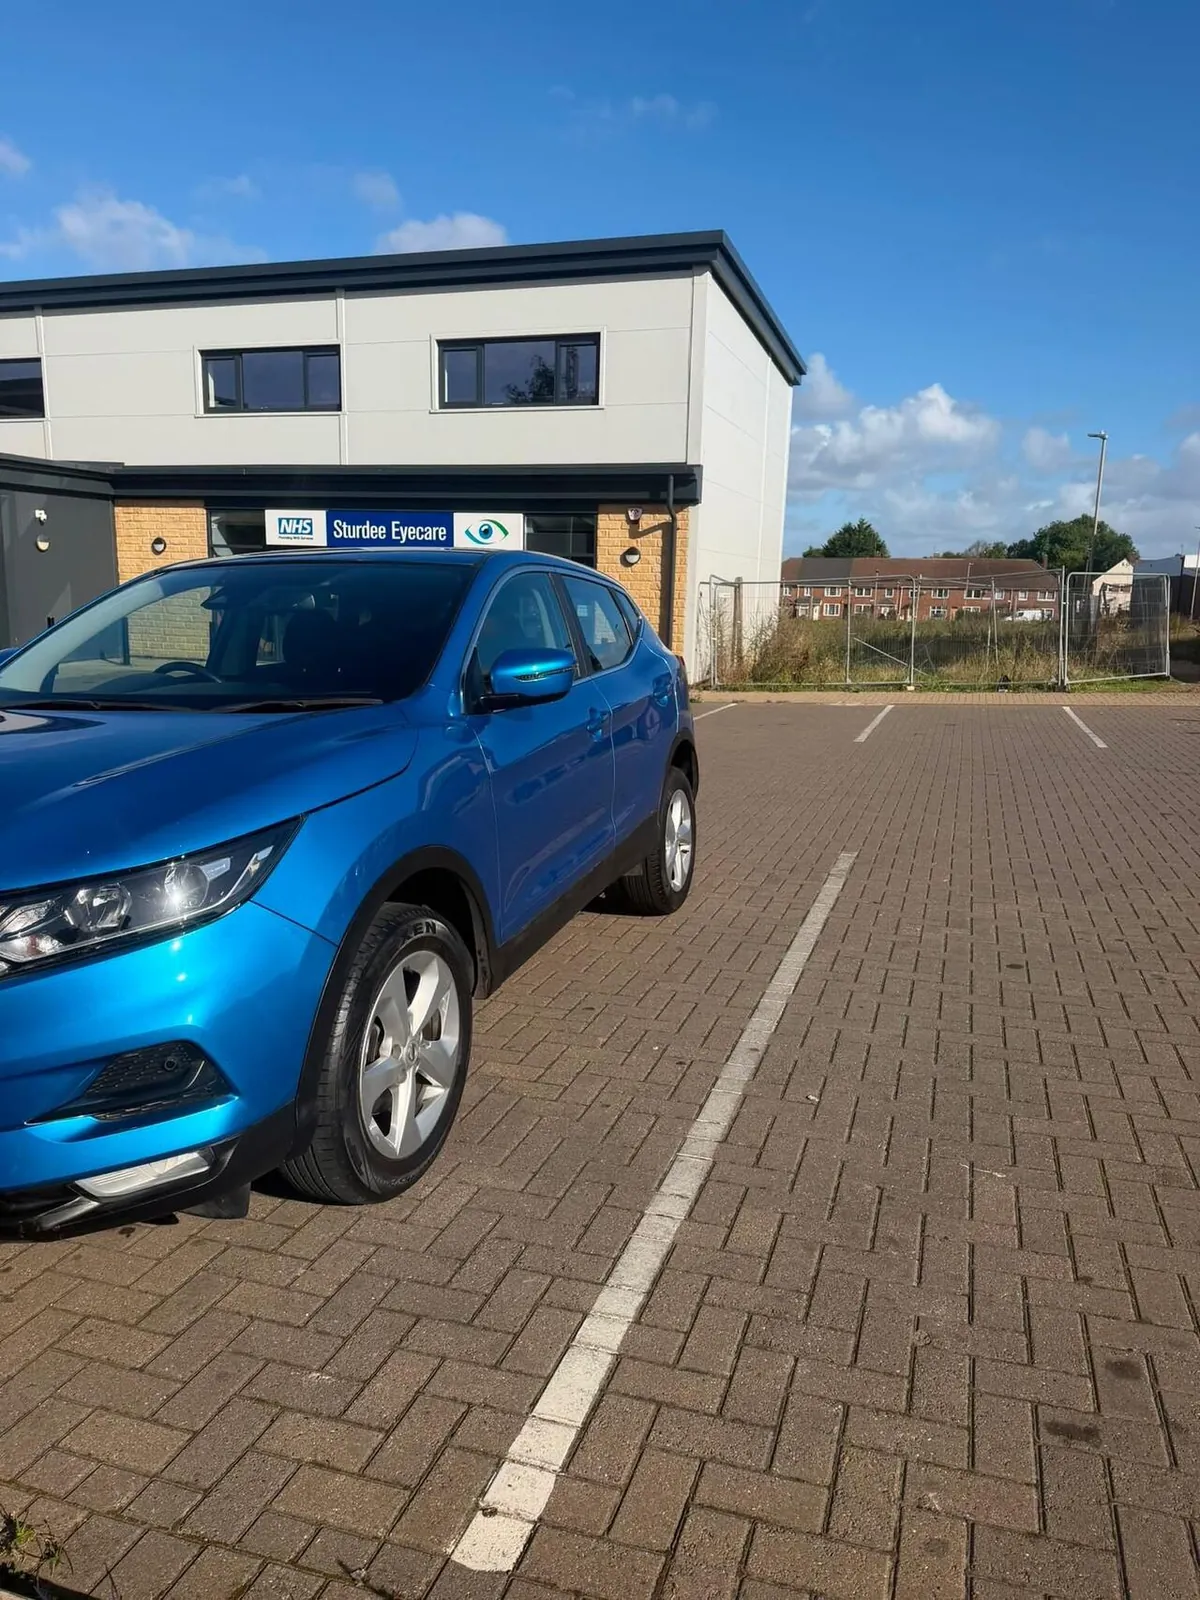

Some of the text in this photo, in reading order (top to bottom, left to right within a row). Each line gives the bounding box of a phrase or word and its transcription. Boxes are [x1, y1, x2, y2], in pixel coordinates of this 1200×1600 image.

[280, 519, 312, 534] NHS
[333, 519, 447, 544] Sturdee Eyecare
